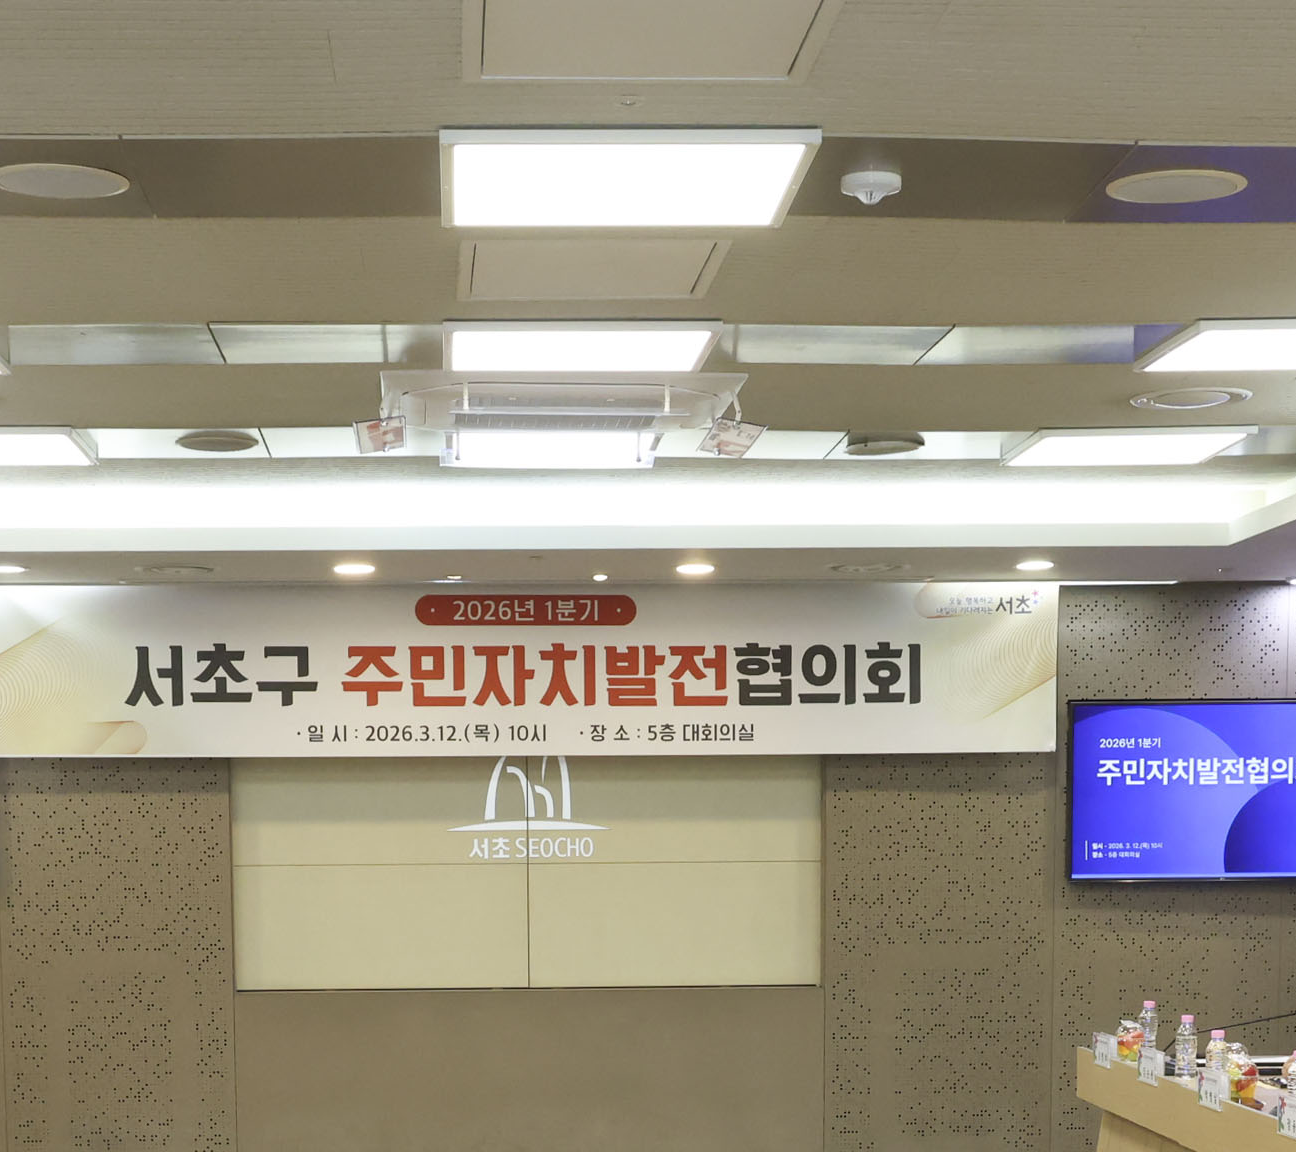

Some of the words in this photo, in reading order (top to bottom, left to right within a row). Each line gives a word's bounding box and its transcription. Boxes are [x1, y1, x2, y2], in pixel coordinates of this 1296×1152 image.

[453, 599, 535, 622] 2026년
[545, 599, 600, 622] 1분기
[995, 595, 1032, 615] 서초
[124, 640, 320, 708] 서초구
[341, 641, 923, 708] 주민자치발전협의회
[365, 723, 500, 743] 2026.3.12.(목)
[507, 724, 547, 742] 10시
[647, 723, 677, 742] 5층
[682, 723, 754, 743] 대회의실
[1099, 737, 1135, 749] 2026년
[1137, 737, 1161, 749] 1분기
[468, 837, 511, 860] 서초
[515, 837, 594, 858] SEOCHO
